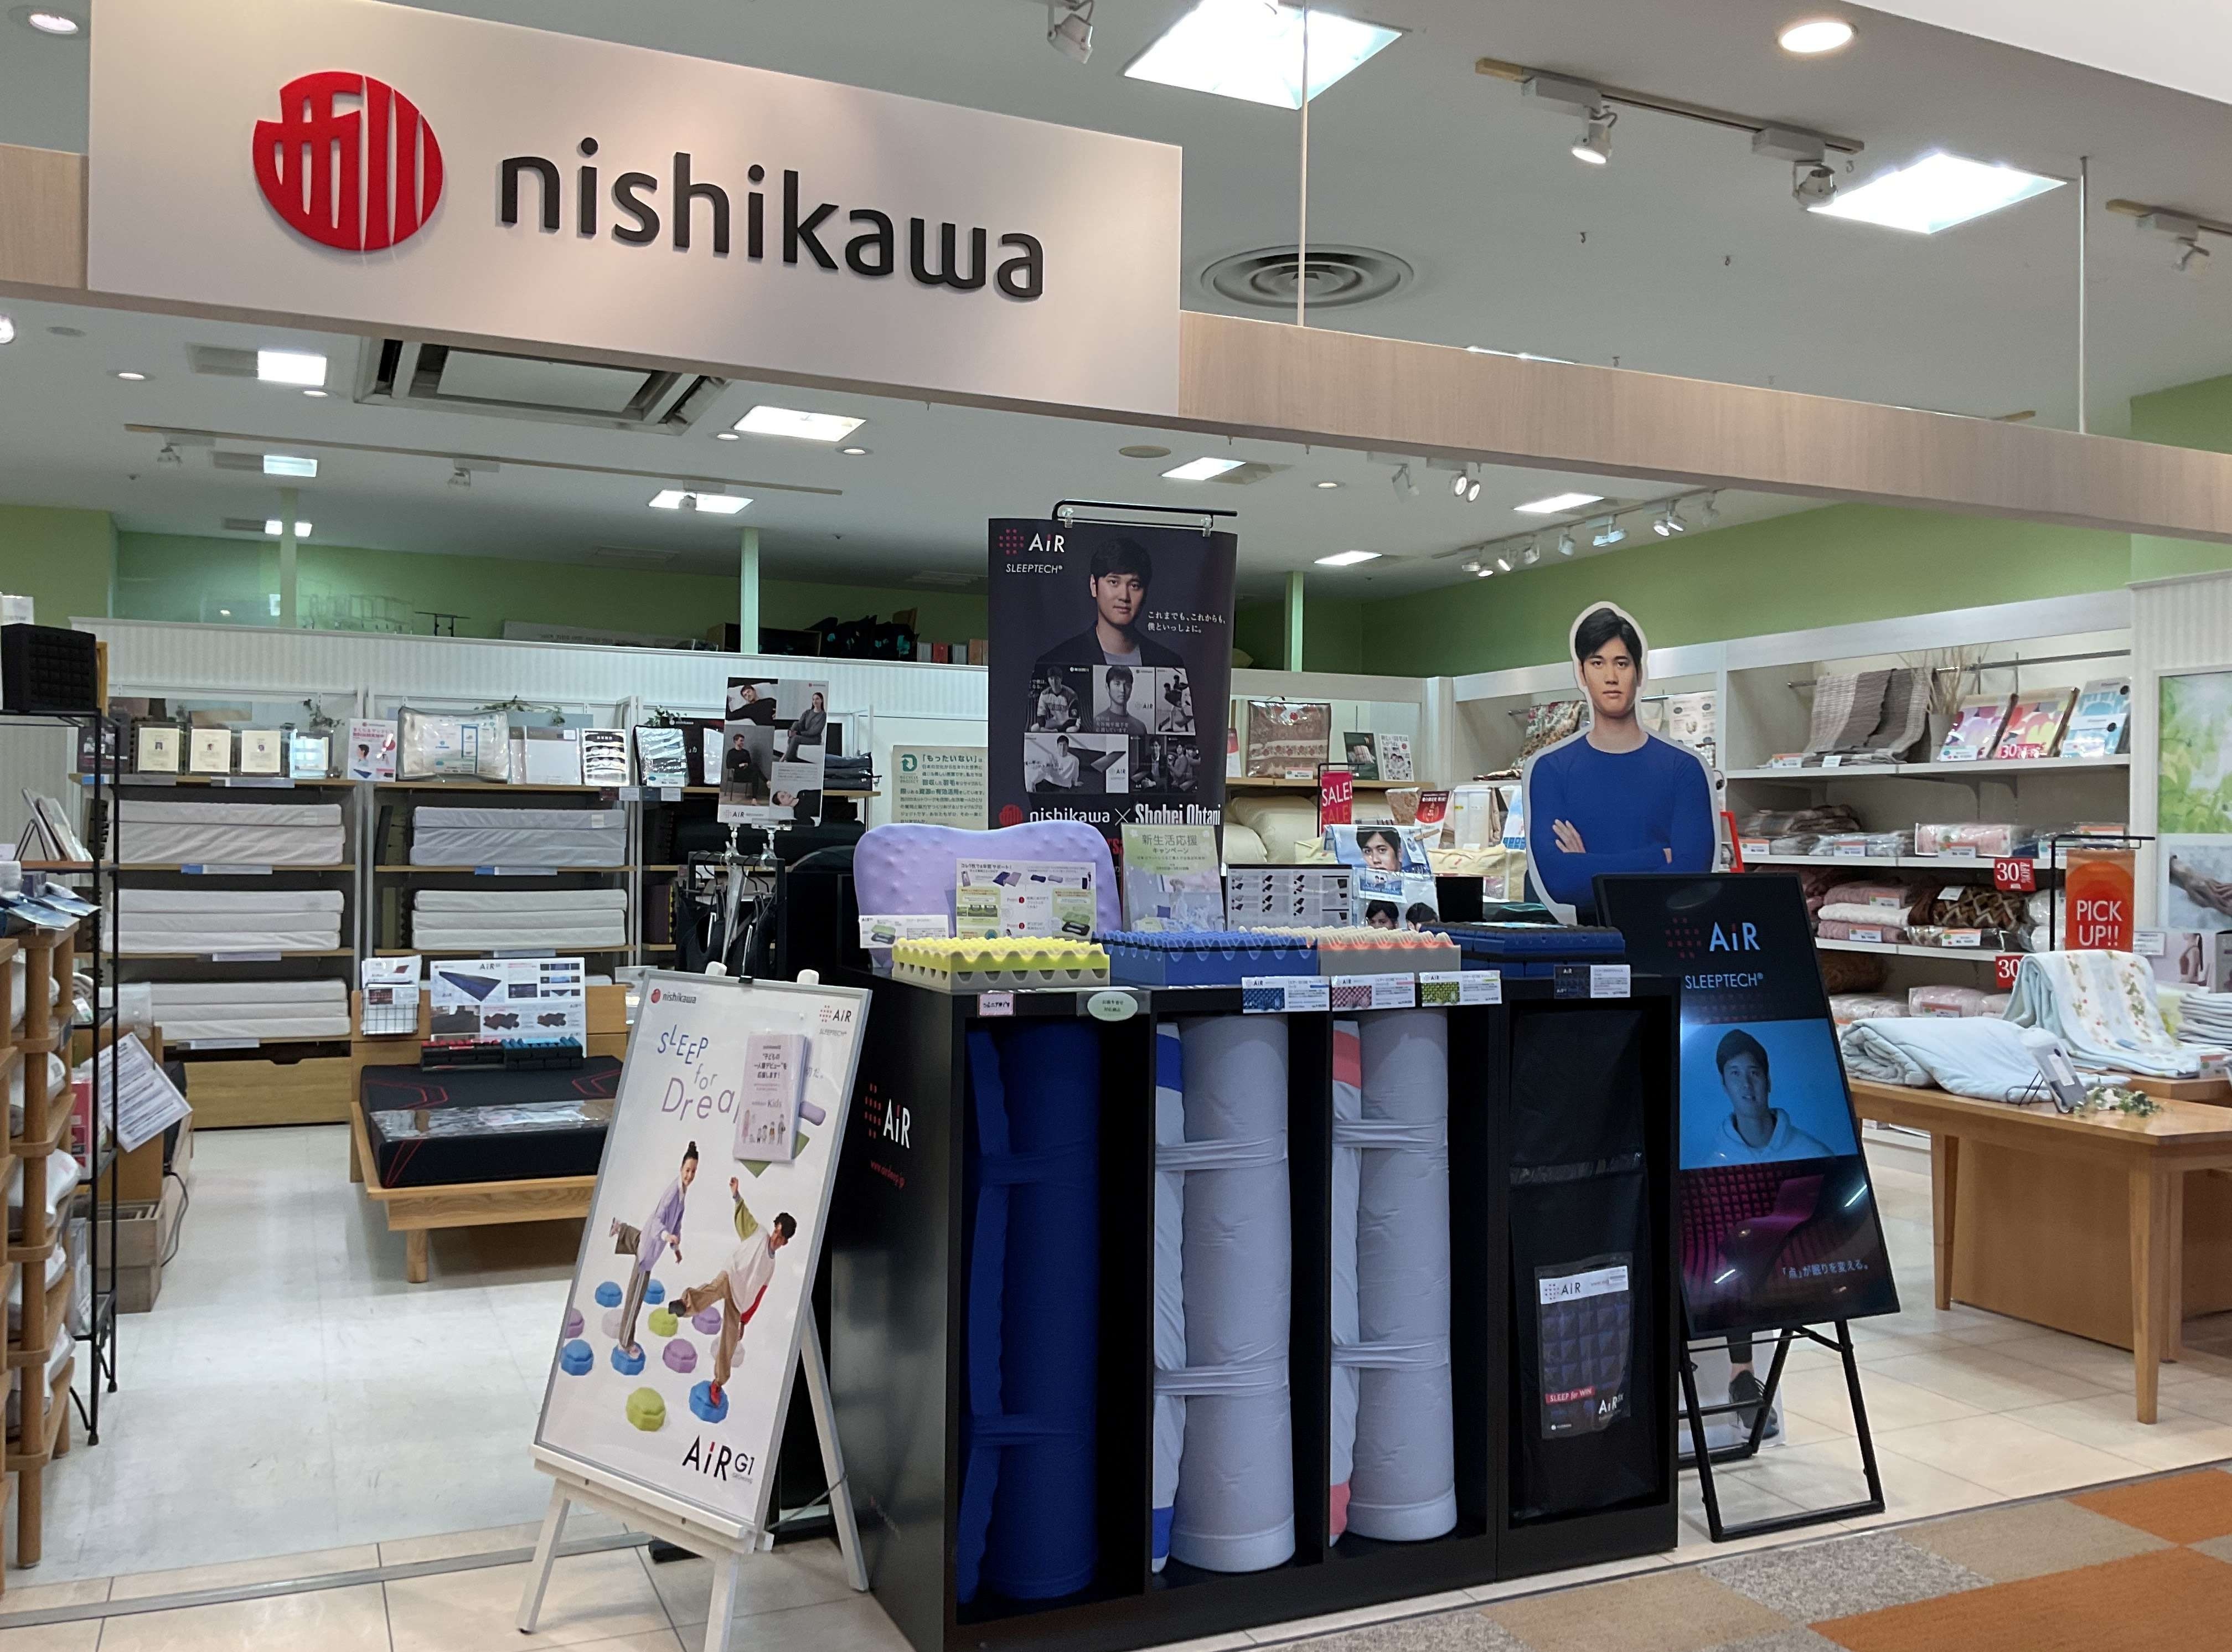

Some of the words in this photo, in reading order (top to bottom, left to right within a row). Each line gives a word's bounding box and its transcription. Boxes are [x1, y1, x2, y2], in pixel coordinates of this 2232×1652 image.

[501, 137, 1043, 299] nishikawa
[1148, 611, 1226, 624] これまでも、これからも、
[1148, 622, 1202, 634] 僕といっしょに。
[1321, 781, 1352, 807] SALE!
[1030, 807, 1110, 823] nishikawa
[1136, 804, 1183, 824] Shohei
[1186, 804, 1221, 825] Ohtani
[1142, 834, 1197, 846] 新生活応援
[1997, 862, 2019, 882] 30
[2076, 900, 2122, 921] PICK
[2078, 925, 2119, 947] UP!!
[1998, 959, 2020, 978] 30
[662, 991, 696, 1004] nishikawa
[657, 1024, 709, 1065] SLEEP
[694, 1062, 718, 1090] for
[662, 1076, 740, 1125] Drea
[1782, 1259, 1869, 1279] 「点」が眠りを変える。
[1549, 1392, 1569, 1402] SLEEP
[1579, 1387, 1592, 1397] WIN
